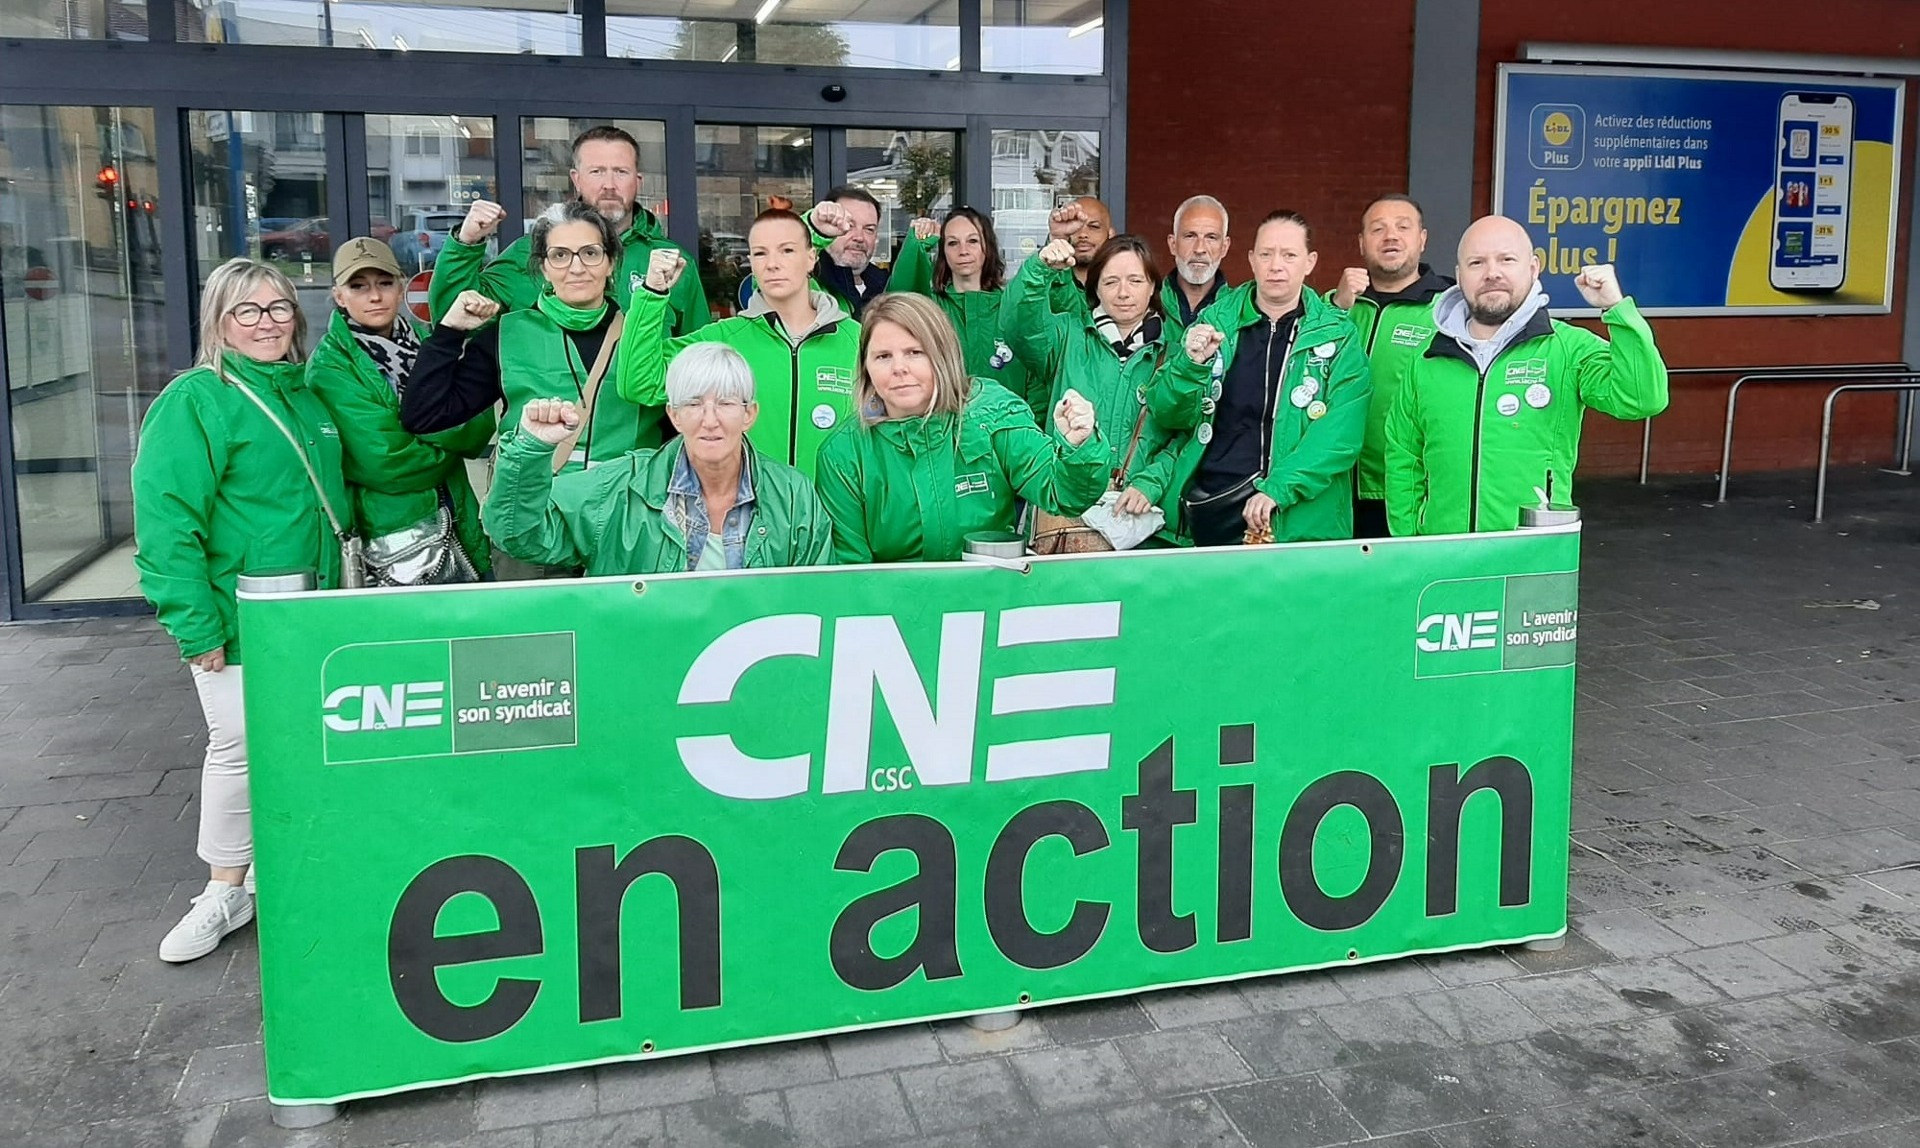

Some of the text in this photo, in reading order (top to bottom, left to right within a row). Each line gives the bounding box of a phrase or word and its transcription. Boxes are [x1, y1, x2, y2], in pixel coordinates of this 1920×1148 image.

[1594, 114, 1713, 130] Activez des réductions
[1593, 135, 1709, 150] supplémentaires dans
[1544, 151, 1570, 165] Plus
[1593, 155, 1703, 171] votre appli Lidl Plus
[1528, 178, 1682, 235] Épargnez
[1416, 611, 1499, 653] CNE
[1506, 624, 1577, 647] son syndica
[560, 680, 571, 695] a
[322, 681, 445, 732] CNE
[458, 699, 572, 724] son syndicat
[676, 600, 1123, 801] CNE
[390, 723, 1534, 1042] en action
